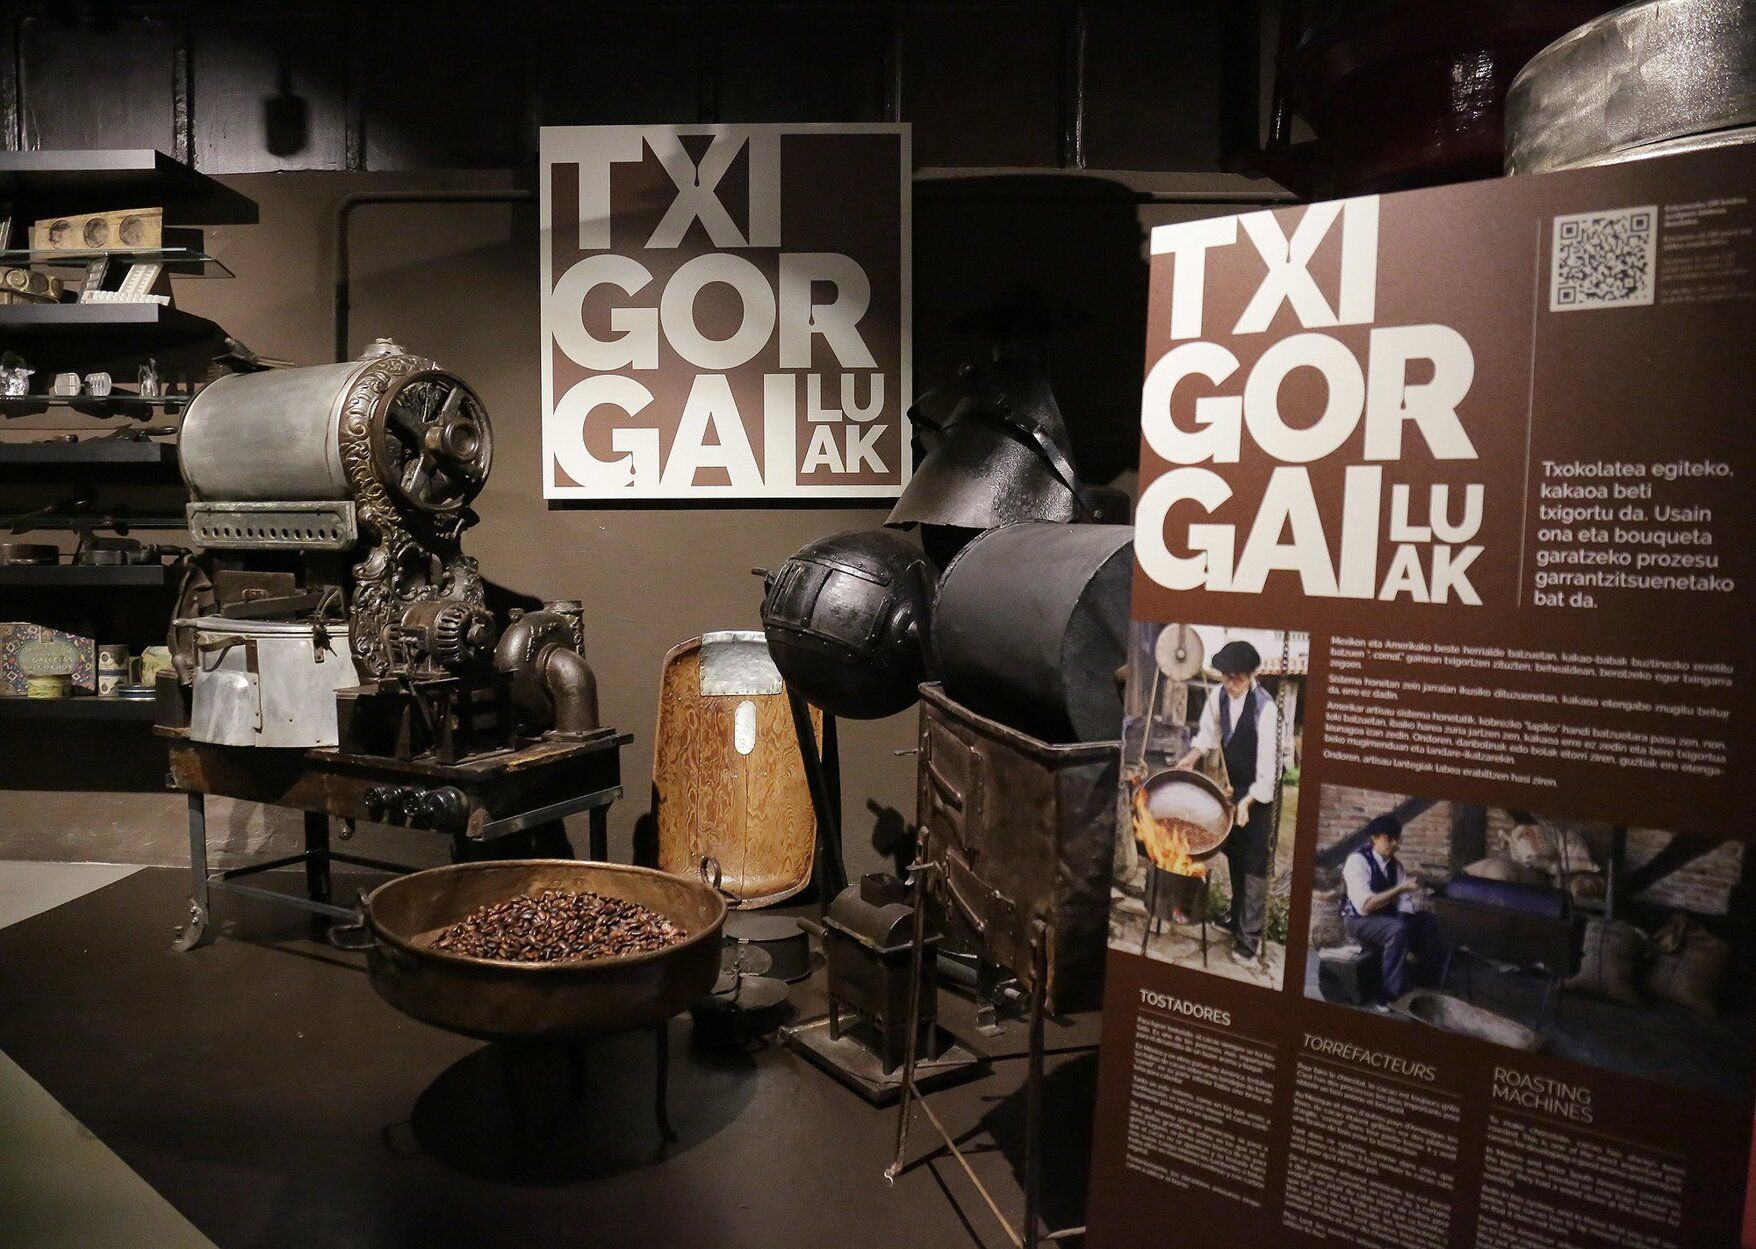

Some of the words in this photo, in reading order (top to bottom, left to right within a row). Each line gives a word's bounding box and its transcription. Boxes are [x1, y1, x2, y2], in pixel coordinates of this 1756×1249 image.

[543, 126, 781, 249] TXI
[1150, 194, 1380, 340] TXI
[551, 252, 879, 371] GOR
[806, 373, 885, 422] LU
[1141, 324, 1478, 464] GOR
[552, 373, 796, 488] GAI
[801, 425, 889, 474] AK
[1542, 460, 1646, 477] Txokolatea
[1540, 482, 1608, 499] kakaoa
[1614, 482, 1652, 499] beti
[1134, 465, 1383, 599] GAI
[1390, 483, 1485, 544] LU
[1539, 505, 1613, 524] txigortu
[1619, 505, 1648, 521] da.
[1654, 505, 1712, 522] Usain
[1537, 528, 1572, 542] ona
[1578, 527, 1608, 543] eta
[1614, 526, 1712, 547] bouqueta
[1379, 545, 1485, 606] AK
[1536, 549, 1632, 567] garatzeko
[1636, 553, 1719, 569] prozesu
[1534, 570, 1735, 592] garrantzitsuenetako
[1534, 590, 1565, 606] bat
[1569, 592, 1597, 608] da.
[1368, 640, 1382, 648] eta
[1139, 988, 1232, 1027] TOSTADORES
[1492, 1084, 1594, 1124] MACHINES
[1494, 1066, 1592, 1105] ROASTING
